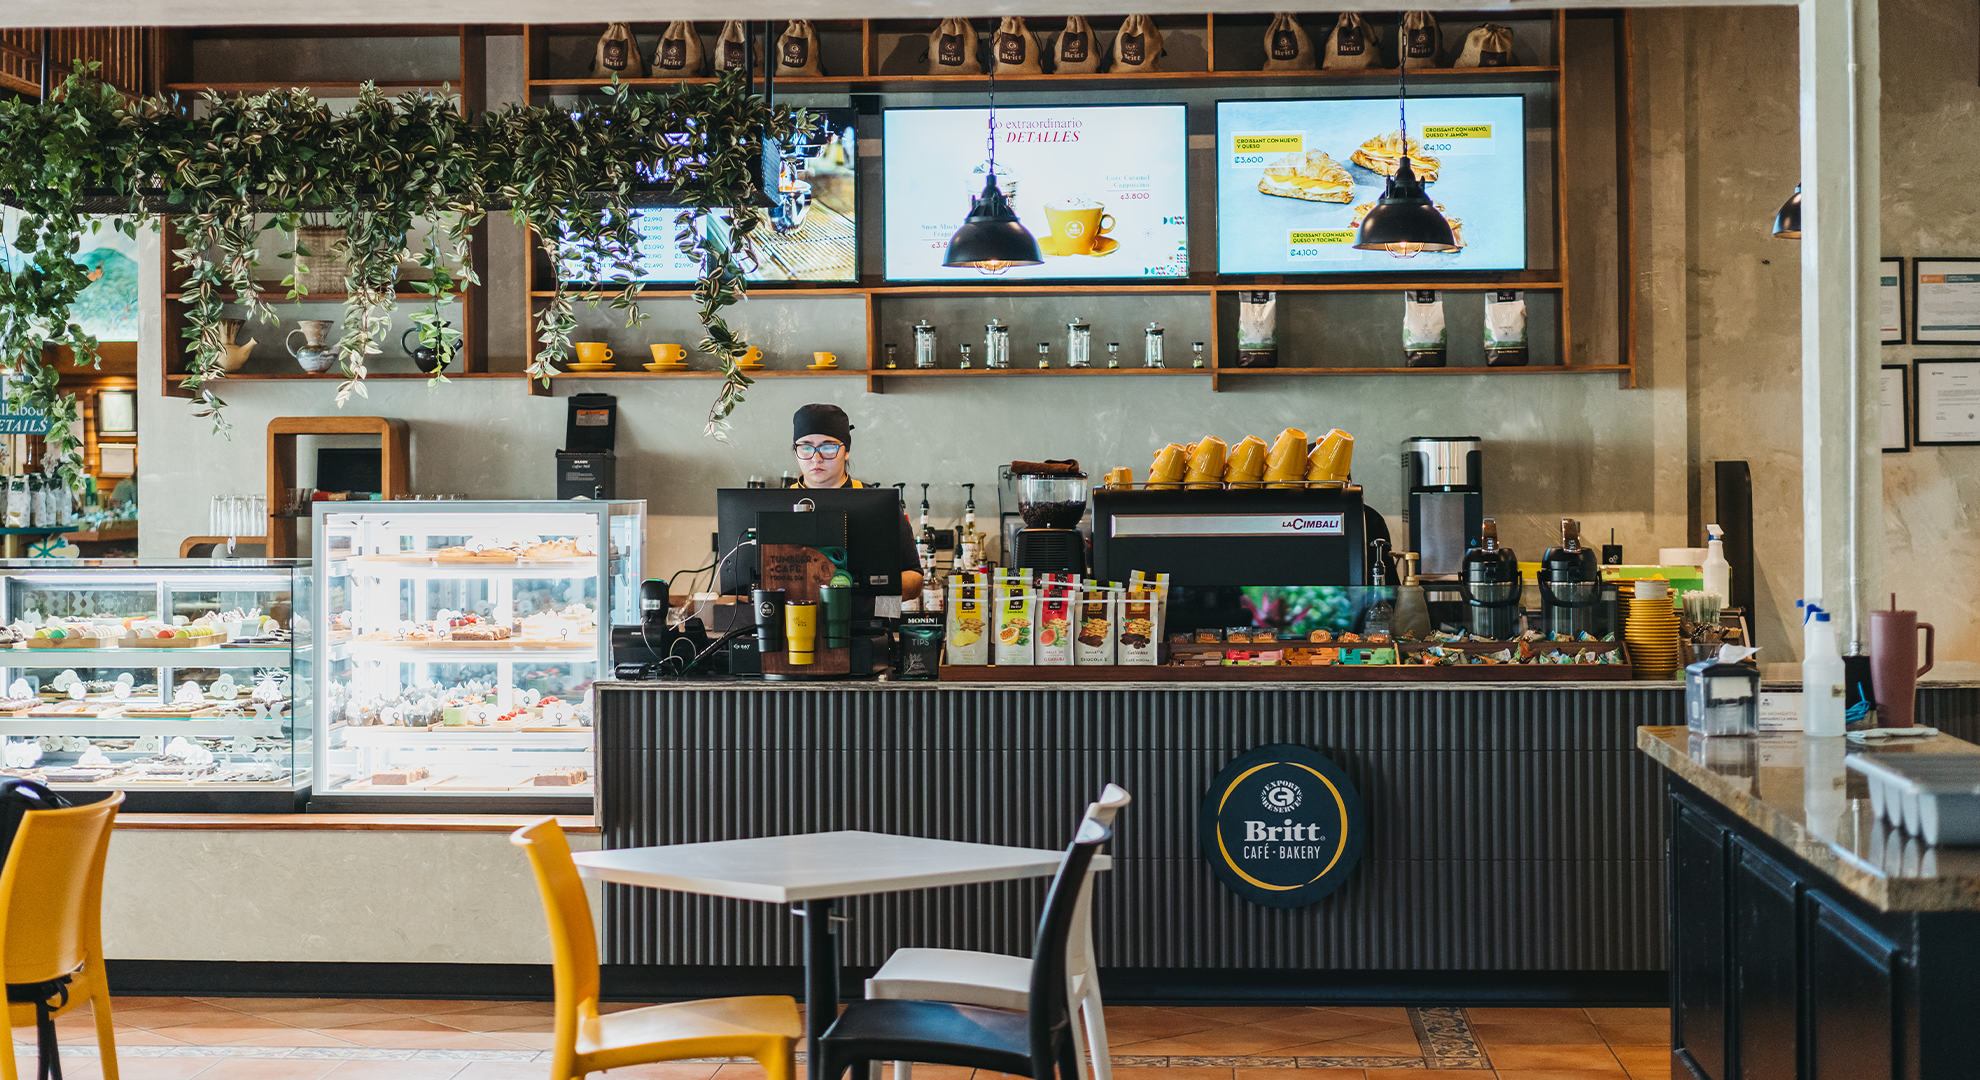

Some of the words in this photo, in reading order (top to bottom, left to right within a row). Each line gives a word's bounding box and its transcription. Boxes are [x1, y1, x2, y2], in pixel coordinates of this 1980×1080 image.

[1006, 118, 1083, 130] extraordinario
[1006, 130, 1081, 143] DETALLES
[770, 555, 812, 564] TUMBLER
[1264, 780, 1300, 792] EXPORT
[1244, 818, 1321, 842] Britt
[1244, 843, 1270, 860] CAFÉ
[1279, 846, 1321, 860] BAKERY
